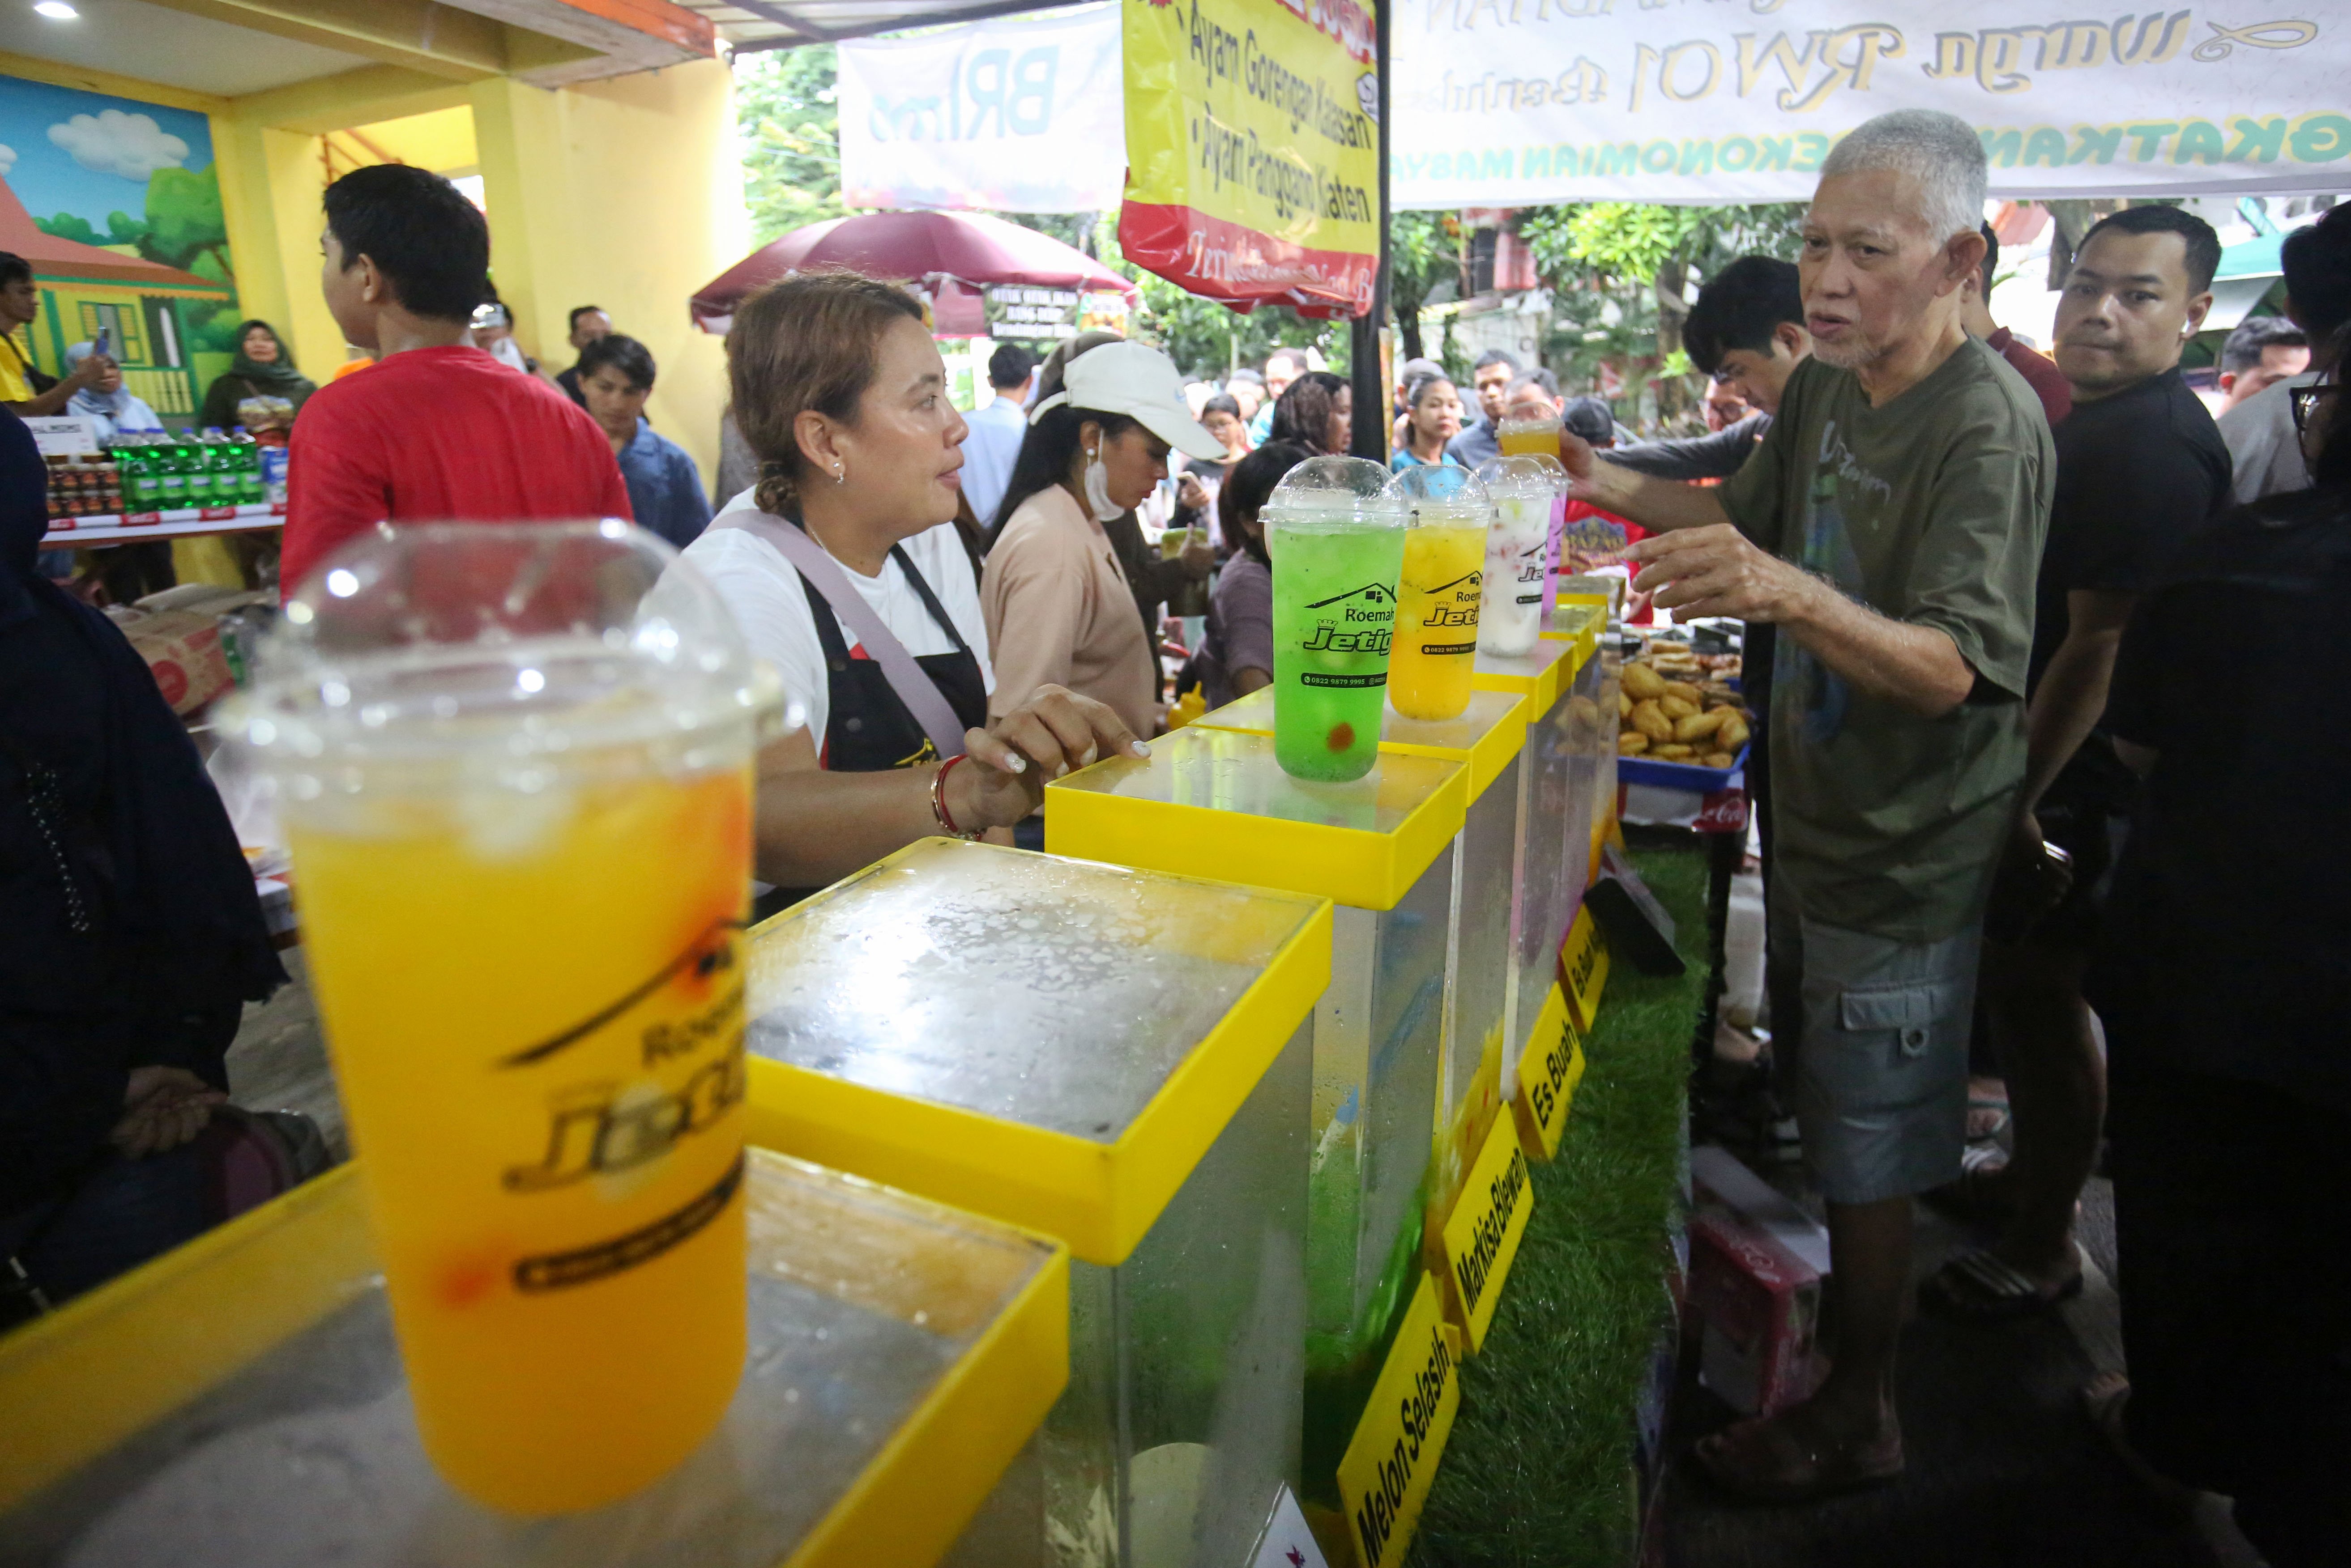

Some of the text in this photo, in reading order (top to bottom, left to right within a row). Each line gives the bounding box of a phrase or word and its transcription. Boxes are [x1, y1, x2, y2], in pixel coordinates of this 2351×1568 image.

[1346, 607, 1394, 622] Roemah
[1423, 605, 1480, 626] Jeti
[1532, 1018, 1578, 1130] Es Buah
[1457, 1208, 1501, 1316] Markisa
[1357, 1325, 1450, 1568] Melon Selasih
